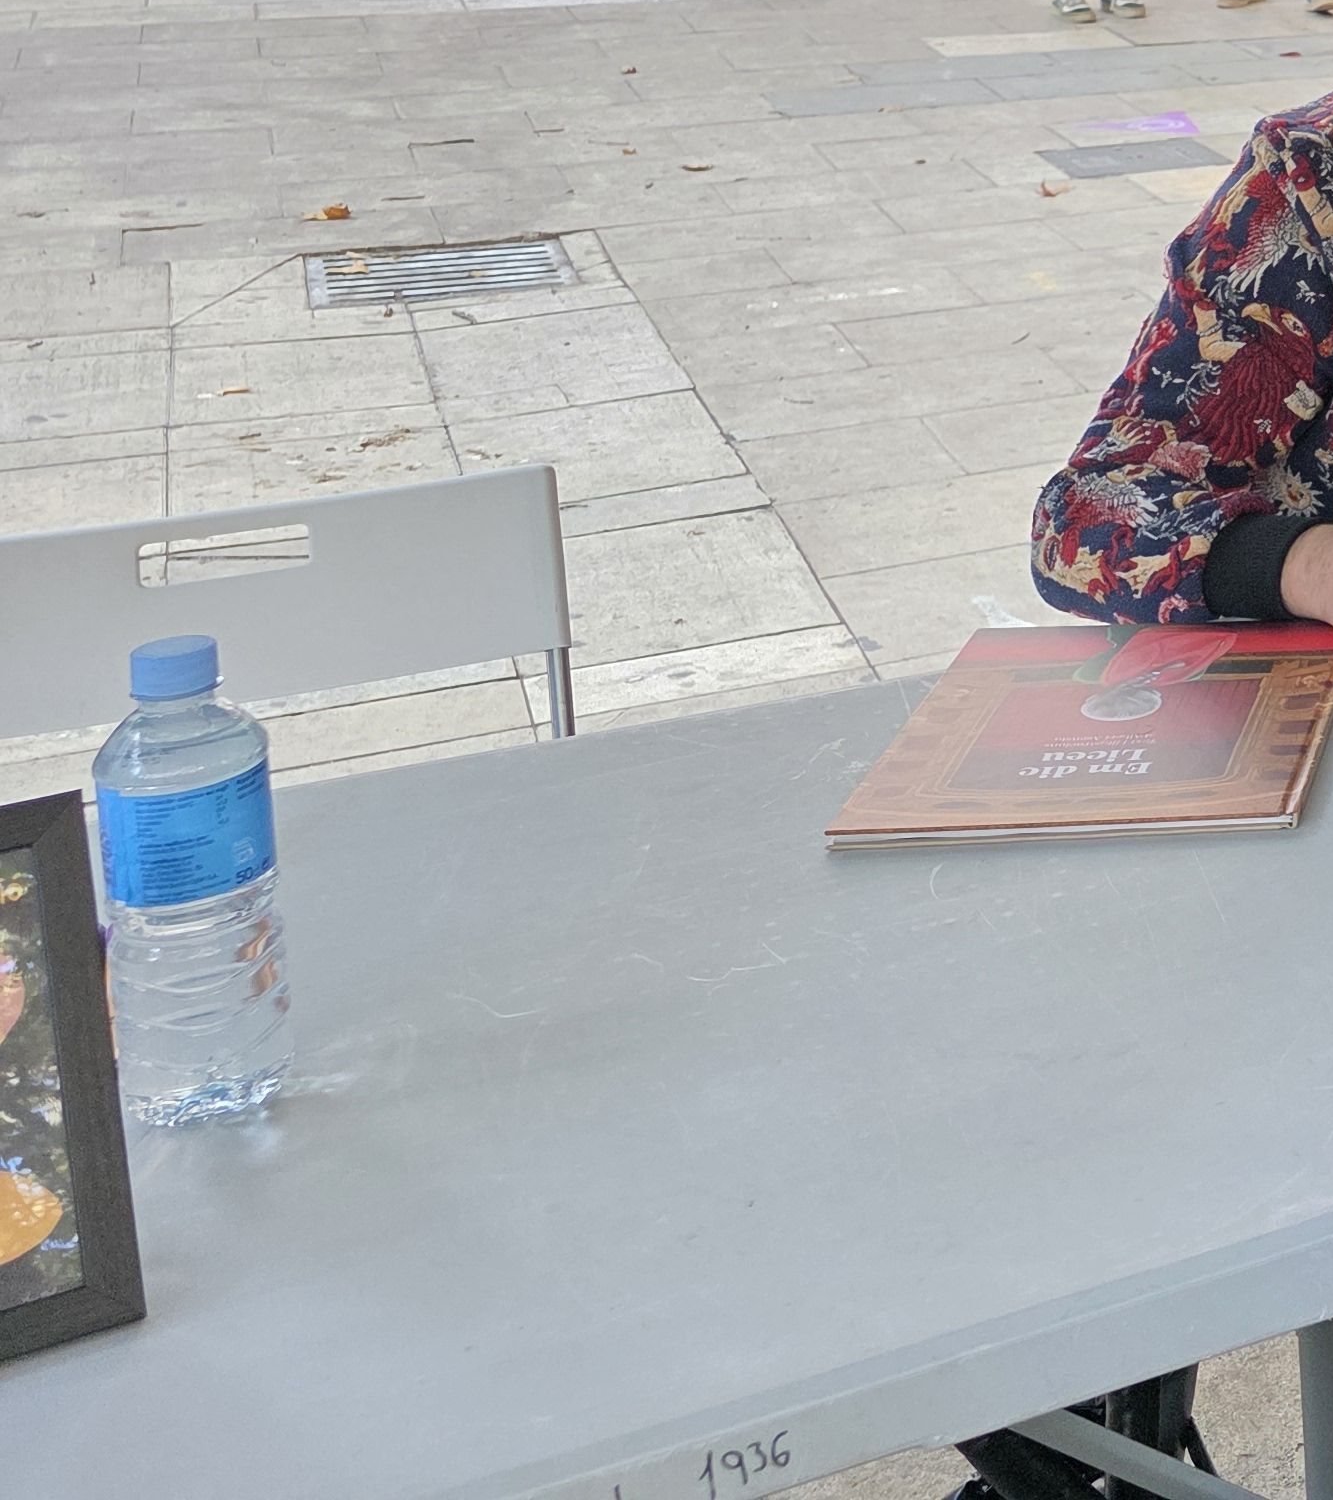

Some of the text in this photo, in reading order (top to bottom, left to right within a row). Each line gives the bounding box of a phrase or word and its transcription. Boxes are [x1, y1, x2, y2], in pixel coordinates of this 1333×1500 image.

[1042, 748, 1148, 762] Liceu
[1018, 761, 1153, 779] Em dic
[699, 1430, 789, 1500] 1936
